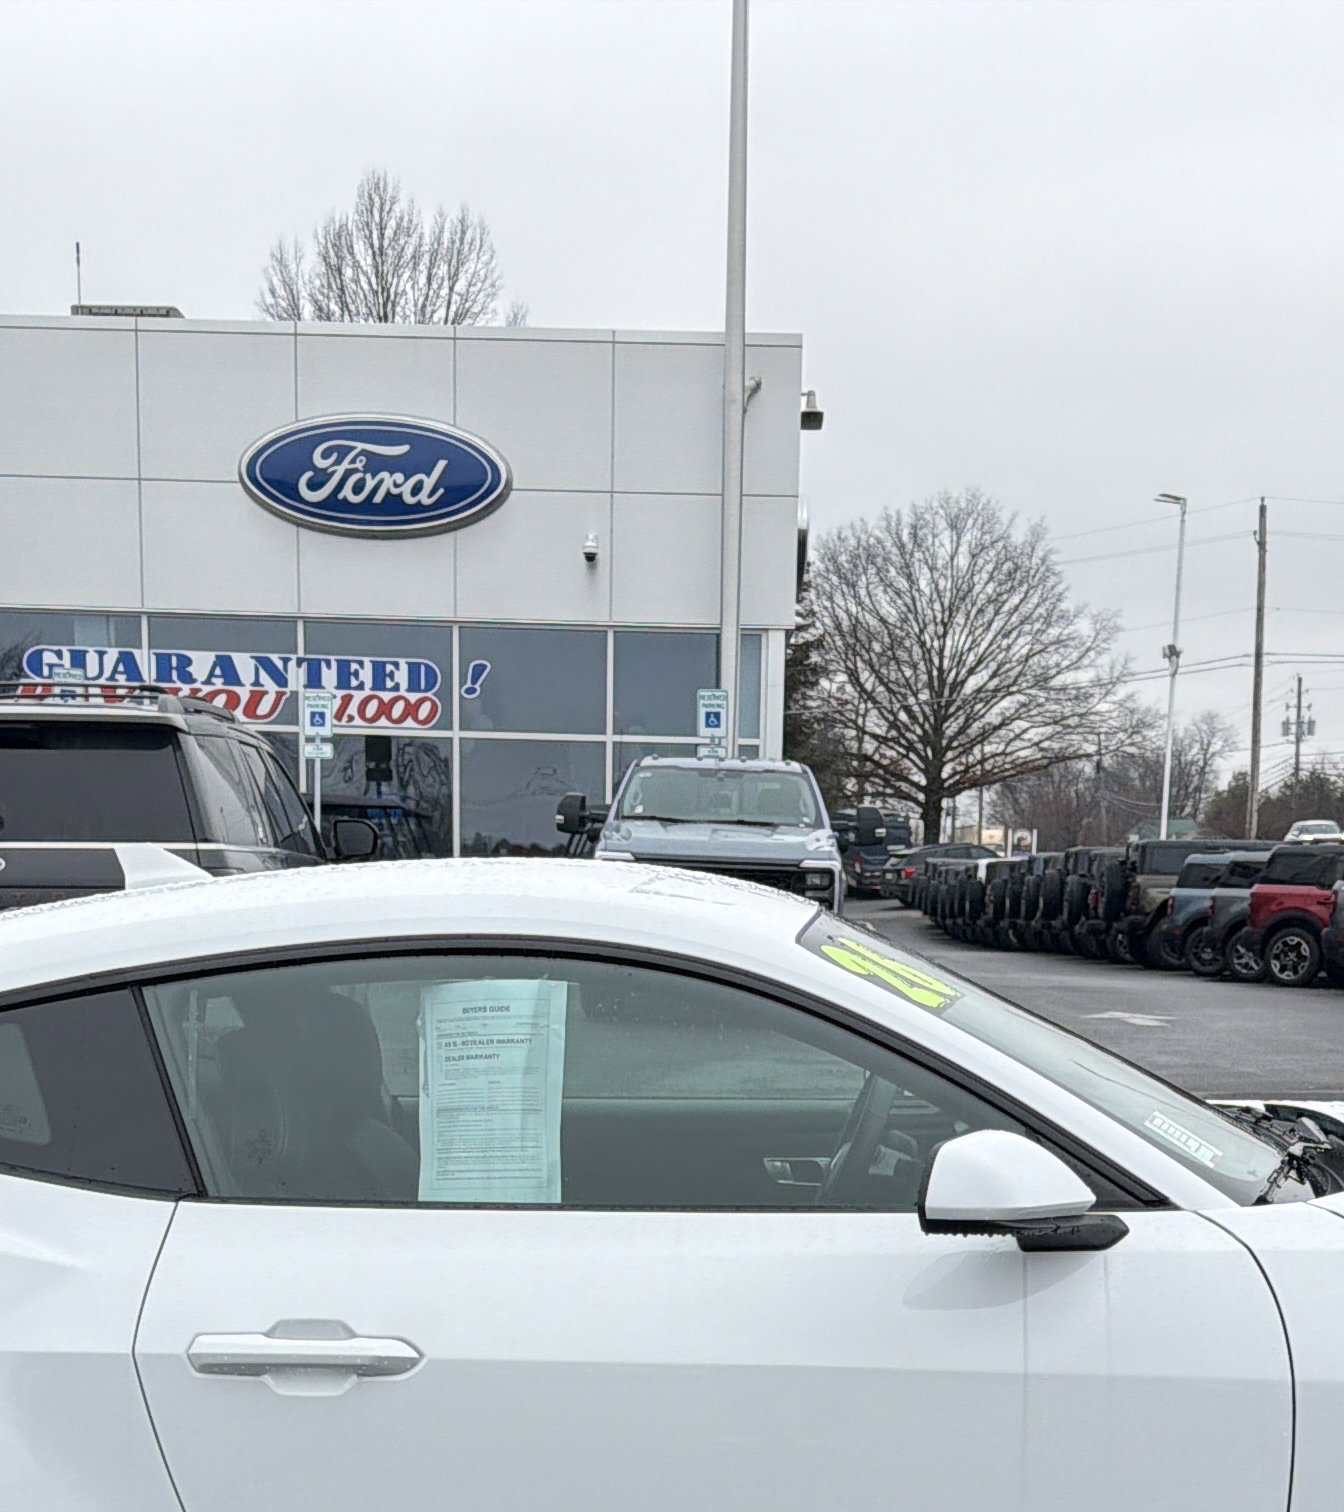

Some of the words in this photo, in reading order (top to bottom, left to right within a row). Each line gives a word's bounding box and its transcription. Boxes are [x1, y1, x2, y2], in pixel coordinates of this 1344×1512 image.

[298, 439, 448, 505] Ford
[25, 648, 441, 693] GUARANTEED
[332, 692, 439, 726] 1,000
